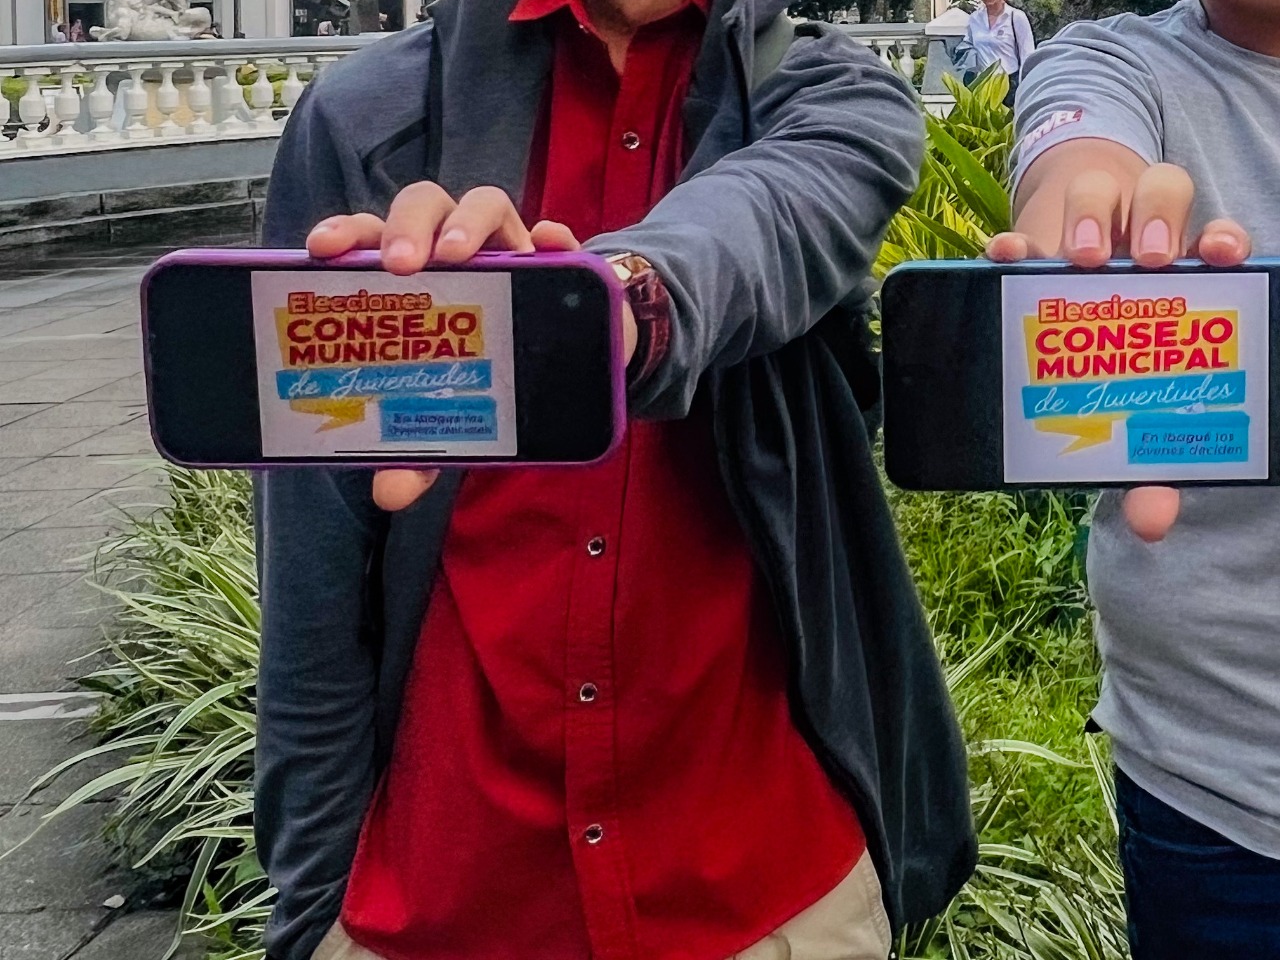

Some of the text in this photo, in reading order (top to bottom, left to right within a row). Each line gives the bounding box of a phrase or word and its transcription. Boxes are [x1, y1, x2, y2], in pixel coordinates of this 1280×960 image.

[288, 289, 432, 314] Elecciones
[1038, 294, 1187, 324] Elecciones
[287, 311, 477, 344] CONSEJO
[1035, 317, 1233, 355] CONSEJO
[289, 337, 478, 365] MUNICIPAL
[1037, 347, 1230, 380] MUNICIPAL
[288, 363, 487, 399] de Juventudes
[1034, 374, 1237, 418] de Juventudes
